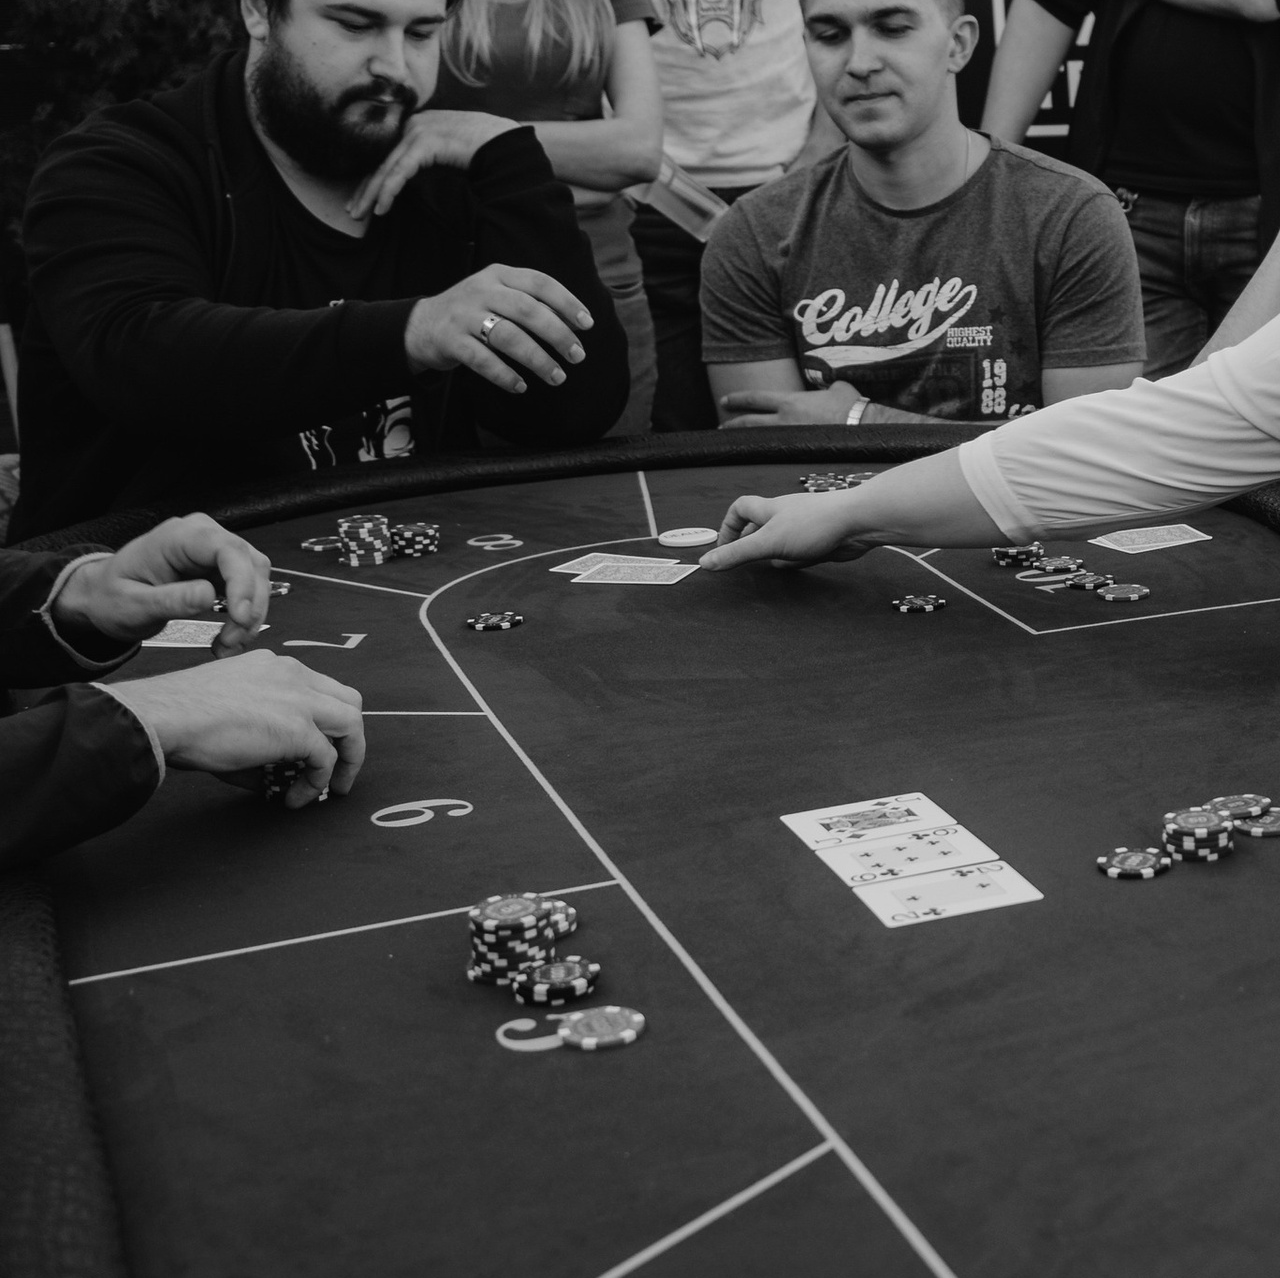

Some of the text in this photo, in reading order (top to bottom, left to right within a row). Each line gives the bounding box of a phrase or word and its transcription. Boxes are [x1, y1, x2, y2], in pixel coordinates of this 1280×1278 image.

[793, 275, 973, 346] College
[946, 325, 994, 337] HIGHEST
[946, 336, 994, 347] QUALITY
[982, 359, 1007, 388] 19
[981, 387, 1007, 415] 88
[466, 533, 525, 551] 8
[283, 632, 368, 649] 7
